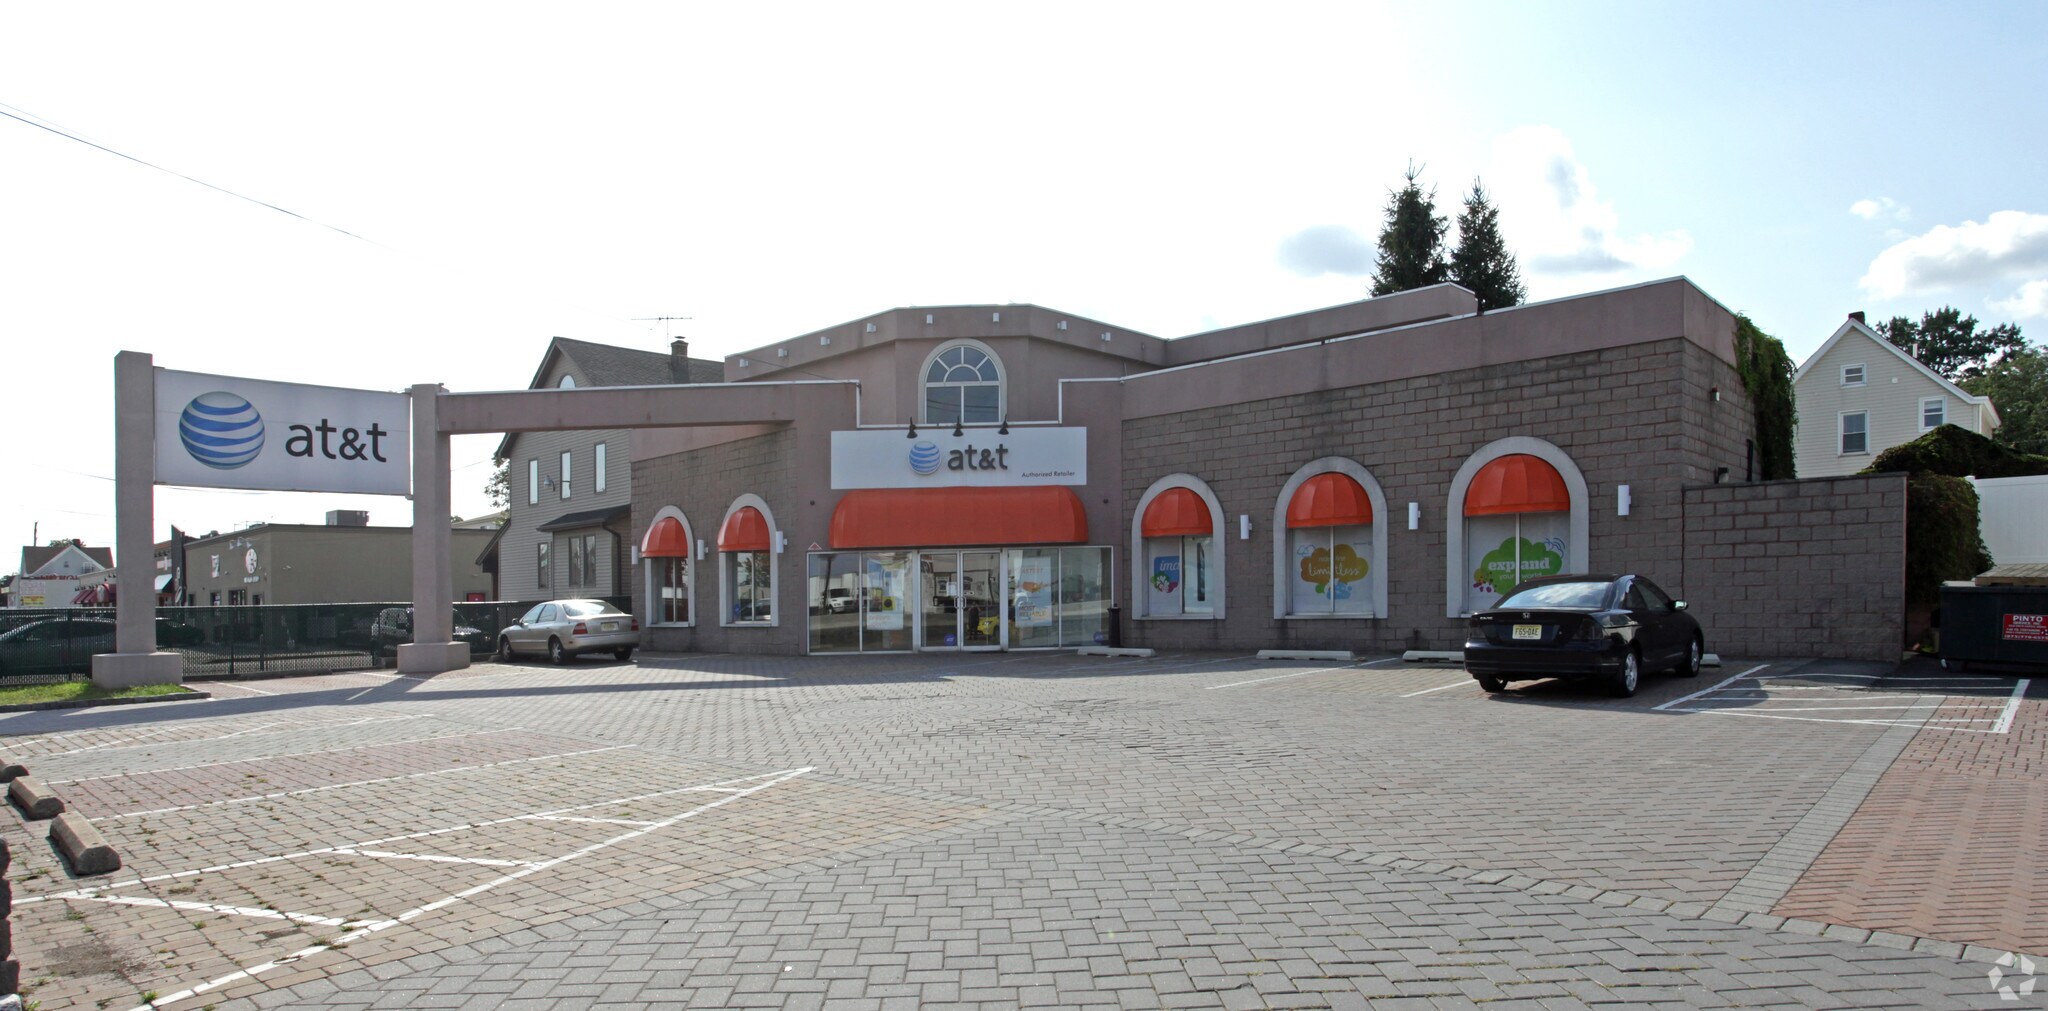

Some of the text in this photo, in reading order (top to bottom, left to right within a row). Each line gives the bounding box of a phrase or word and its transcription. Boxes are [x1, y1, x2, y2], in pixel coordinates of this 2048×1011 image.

[285, 419, 387, 463] at&t
[947, 443, 1009, 470] at&t
[1488, 557, 1550, 573] expand
